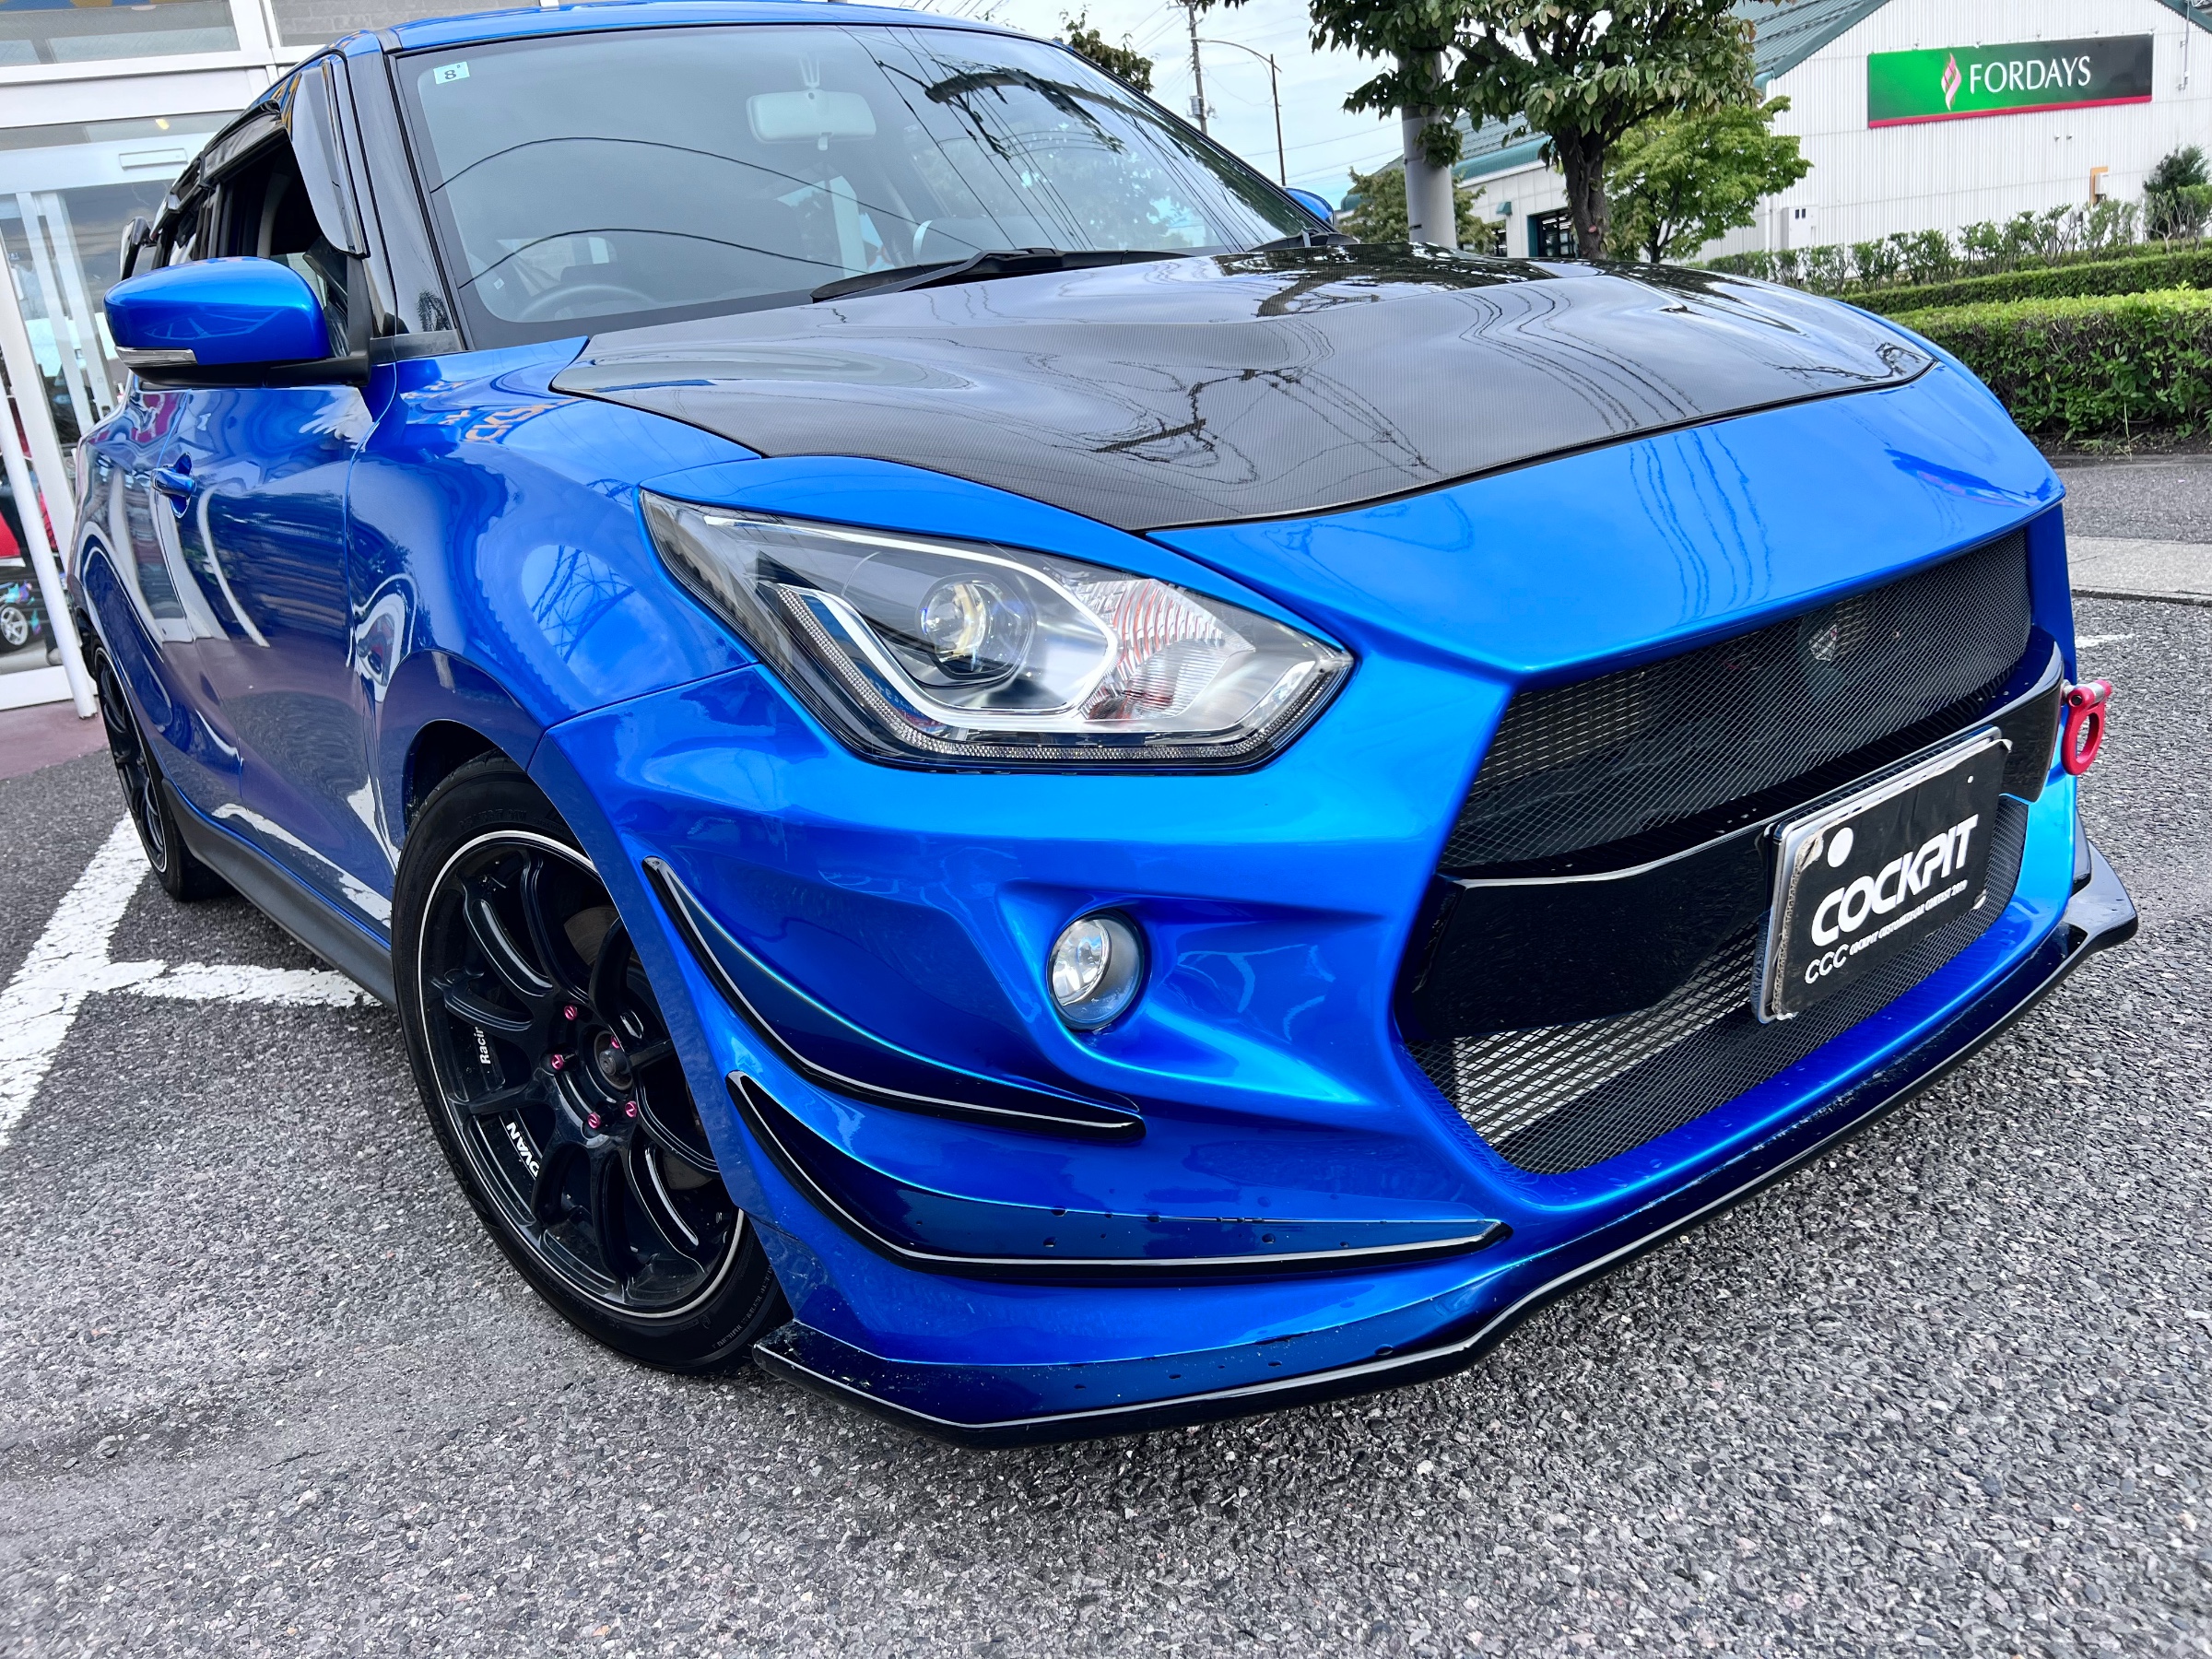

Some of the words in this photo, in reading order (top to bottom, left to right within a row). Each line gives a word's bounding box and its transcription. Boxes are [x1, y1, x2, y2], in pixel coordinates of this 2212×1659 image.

[444, 69, 456, 80] 8
[1969, 55, 2091, 95] FORDAYS
[1811, 814, 1979, 947] COCKPIT
[1805, 943, 1849, 984] CCC
[473, 1026, 491, 1065] Raci
[506, 1122, 540, 1178] DVAN
